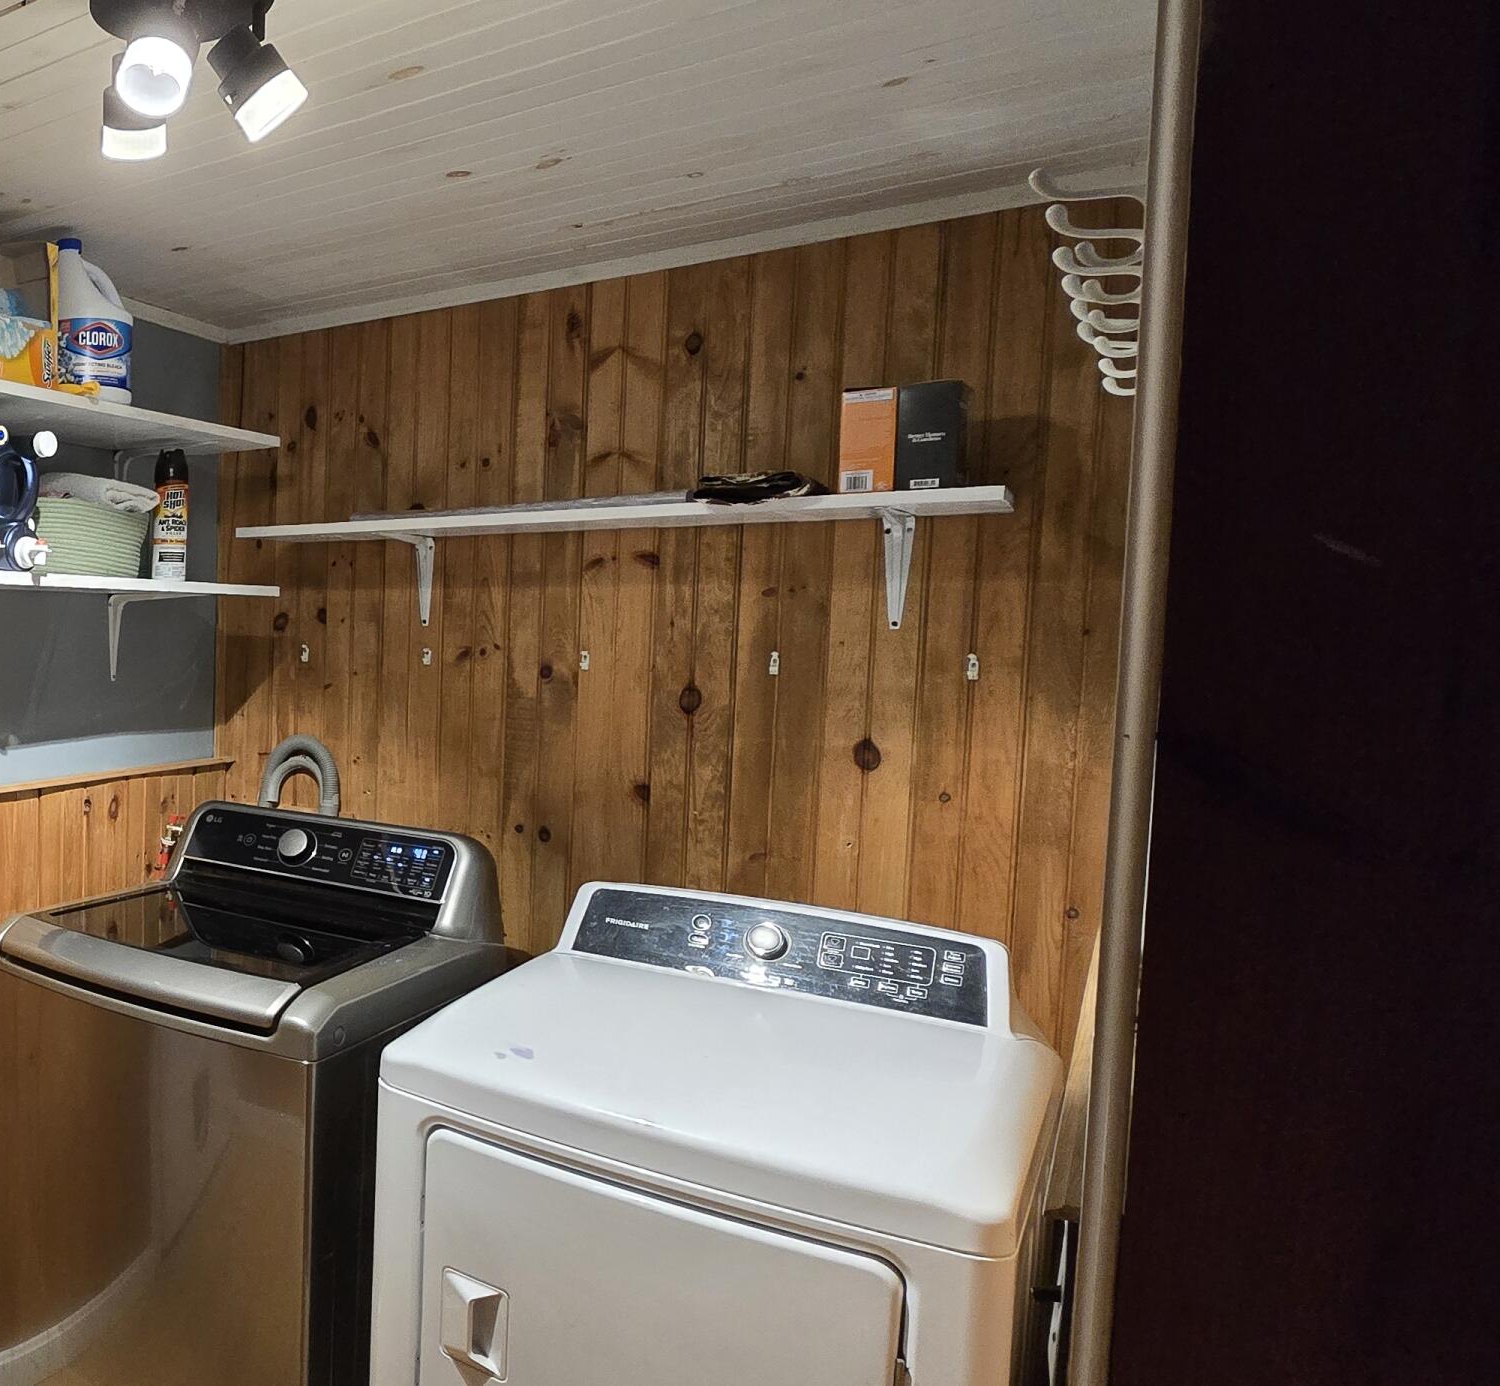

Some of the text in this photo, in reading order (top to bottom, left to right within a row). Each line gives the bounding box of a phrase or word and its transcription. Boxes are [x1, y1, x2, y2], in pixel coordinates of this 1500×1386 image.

[78, 331, 119, 348] CLOROX
[166, 491, 184, 500] HOT
[163, 499, 185, 509] SHOT
[605, 917, 650, 931] FRIGIDAIRE
